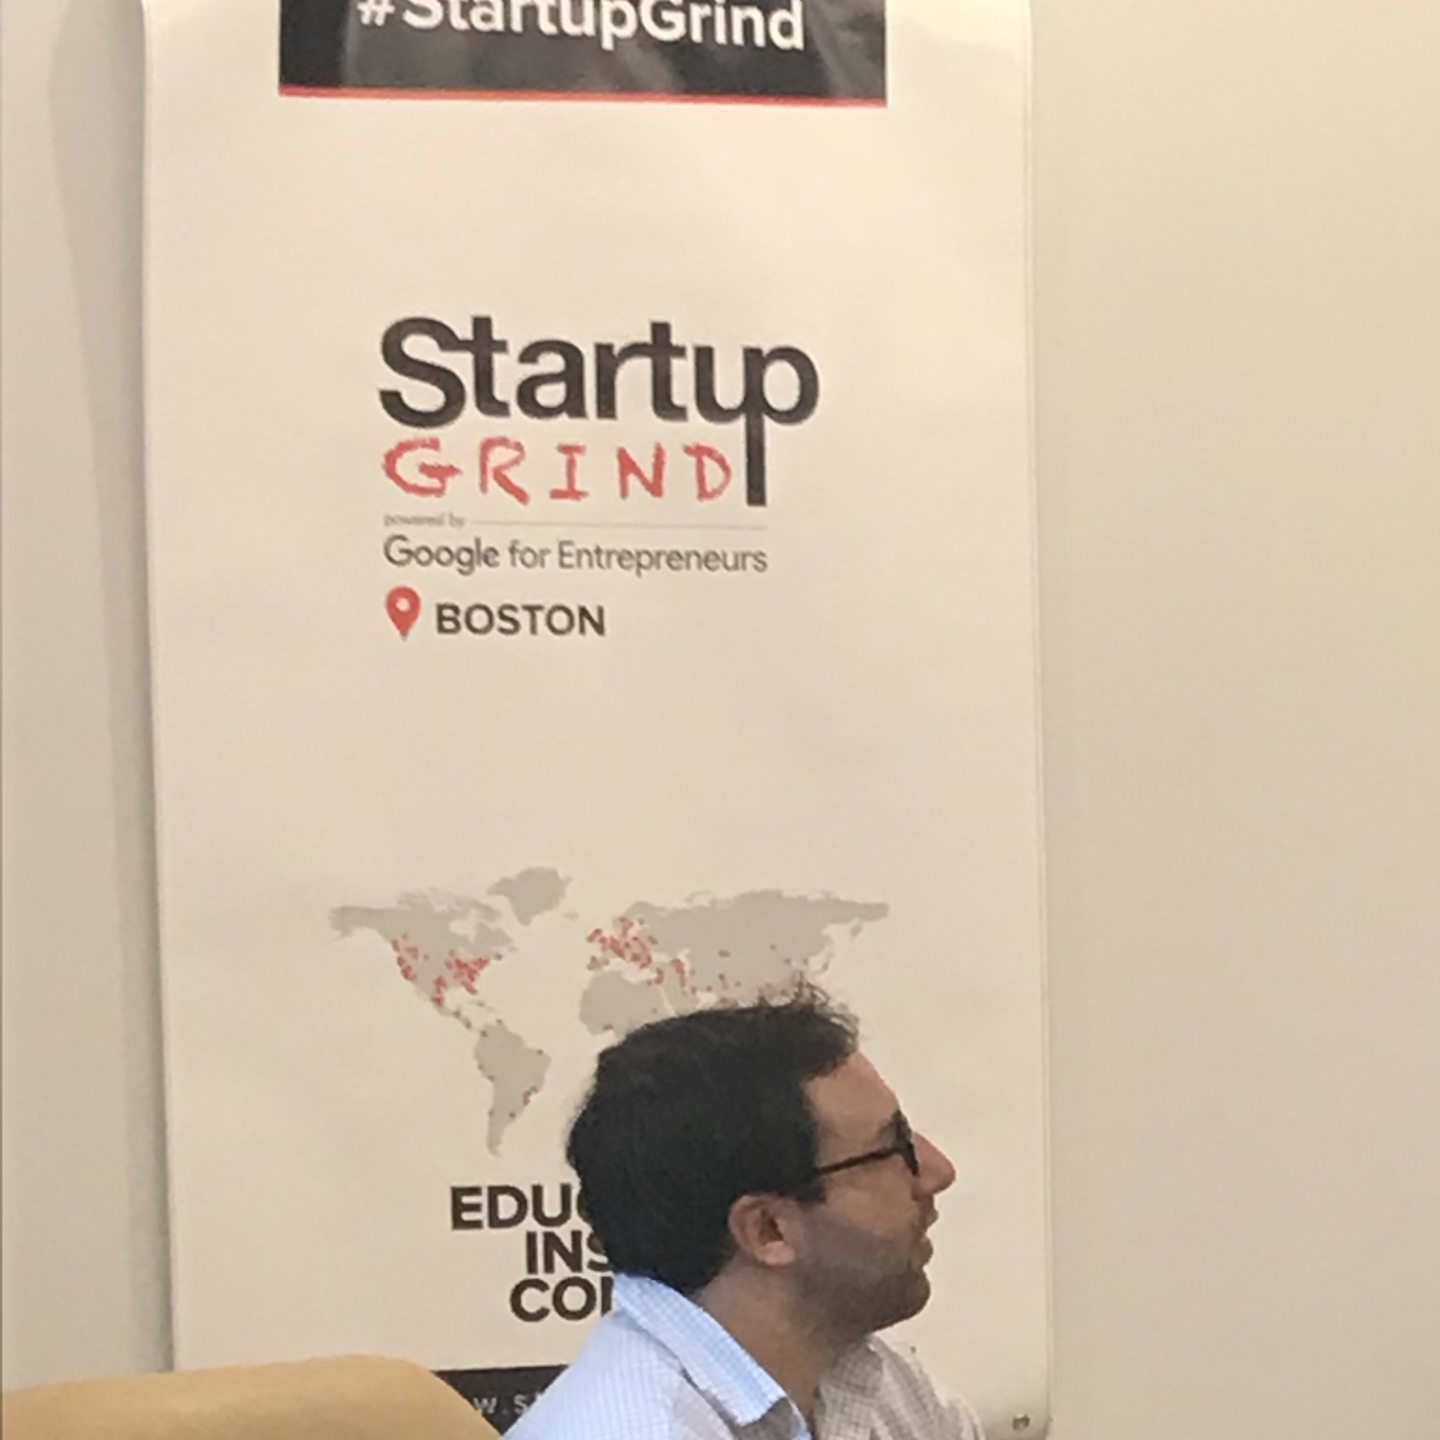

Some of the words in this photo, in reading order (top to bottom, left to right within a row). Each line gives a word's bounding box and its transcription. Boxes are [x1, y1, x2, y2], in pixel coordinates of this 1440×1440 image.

[357, 0, 805, 50] #StartupGrind
[378, 315, 820, 507] Startup
[382, 436, 733, 505] GRIND
[383, 514, 445, 528] powered
[383, 534, 501, 576] Google
[508, 540, 552, 569] for
[558, 540, 769, 578] Entrepreneurs
[436, 603, 607, 636] BOSTON
[450, 1183, 592, 1231] EDU
